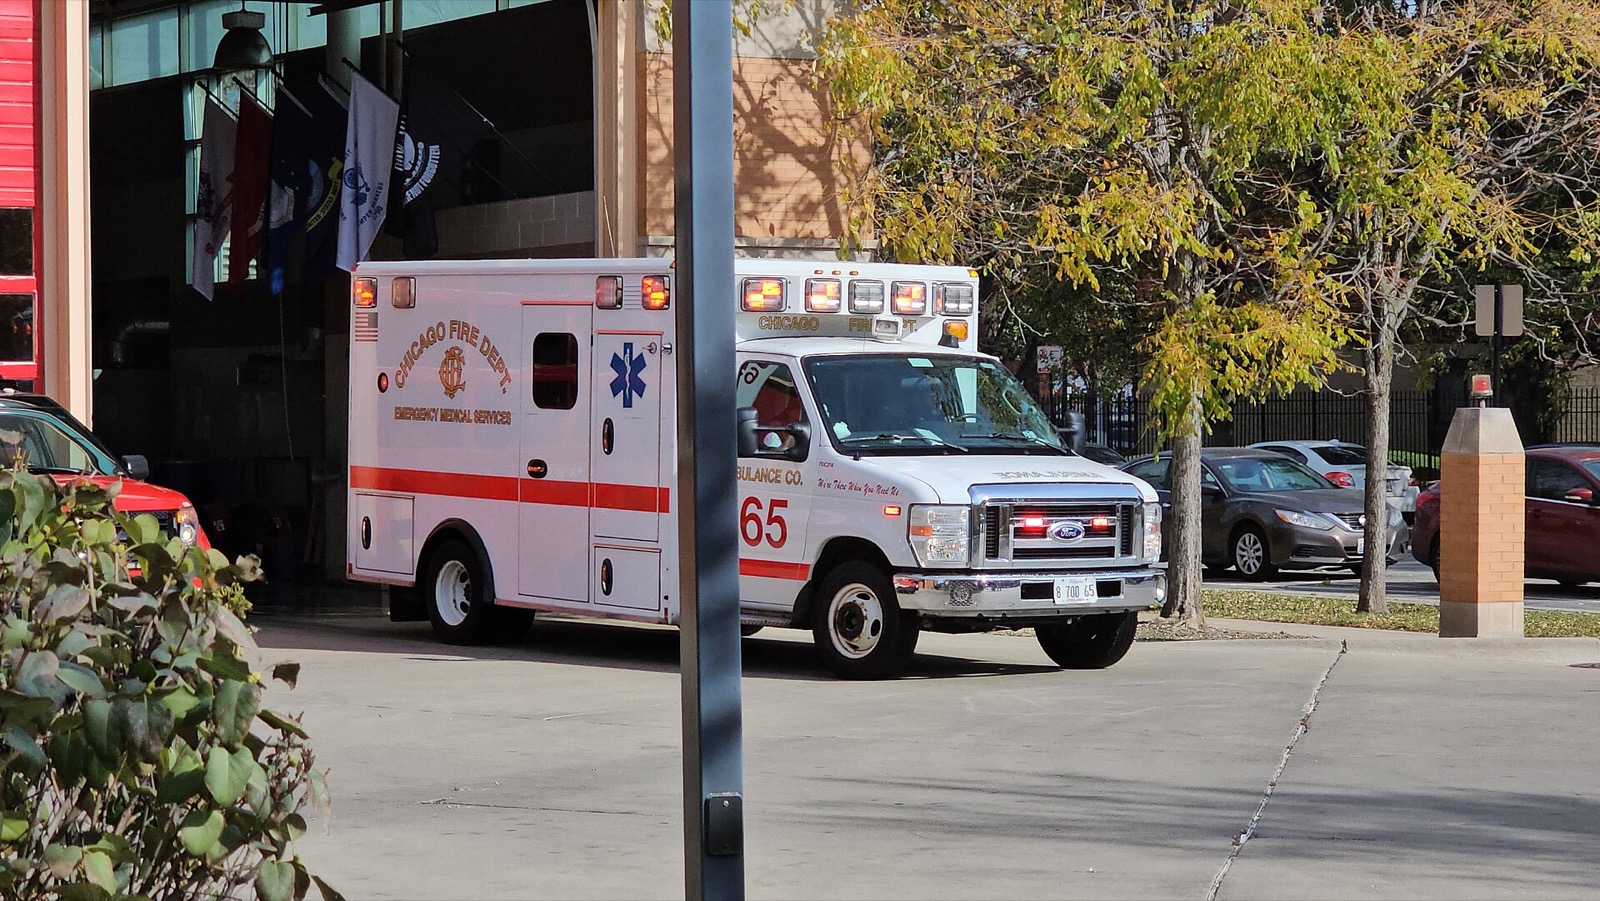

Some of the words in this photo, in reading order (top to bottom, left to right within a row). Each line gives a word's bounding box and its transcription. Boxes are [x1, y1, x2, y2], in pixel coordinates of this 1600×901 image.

[758, 315, 820, 332] CHICAGO
[848, 317, 873, 333] FIR
[395, 321, 446, 389] CHICAGO
[449, 319, 480, 348] FIRE
[394, 406, 439, 421] EMERGENCY
[439, 407, 473, 423] MEDICAL
[473, 408, 512, 425] SERVICES
[785, 468, 804, 486] CO.
[833, 479, 847, 490] There
[847, 481, 862, 492] When
[863, 482, 874, 497] You
[875, 484, 890, 495] Need
[890, 486, 900, 496] Us
[740, 496, 789, 549] 65
[1060, 527, 1078, 537] Ford
[1084, 584, 1095, 597] 65
